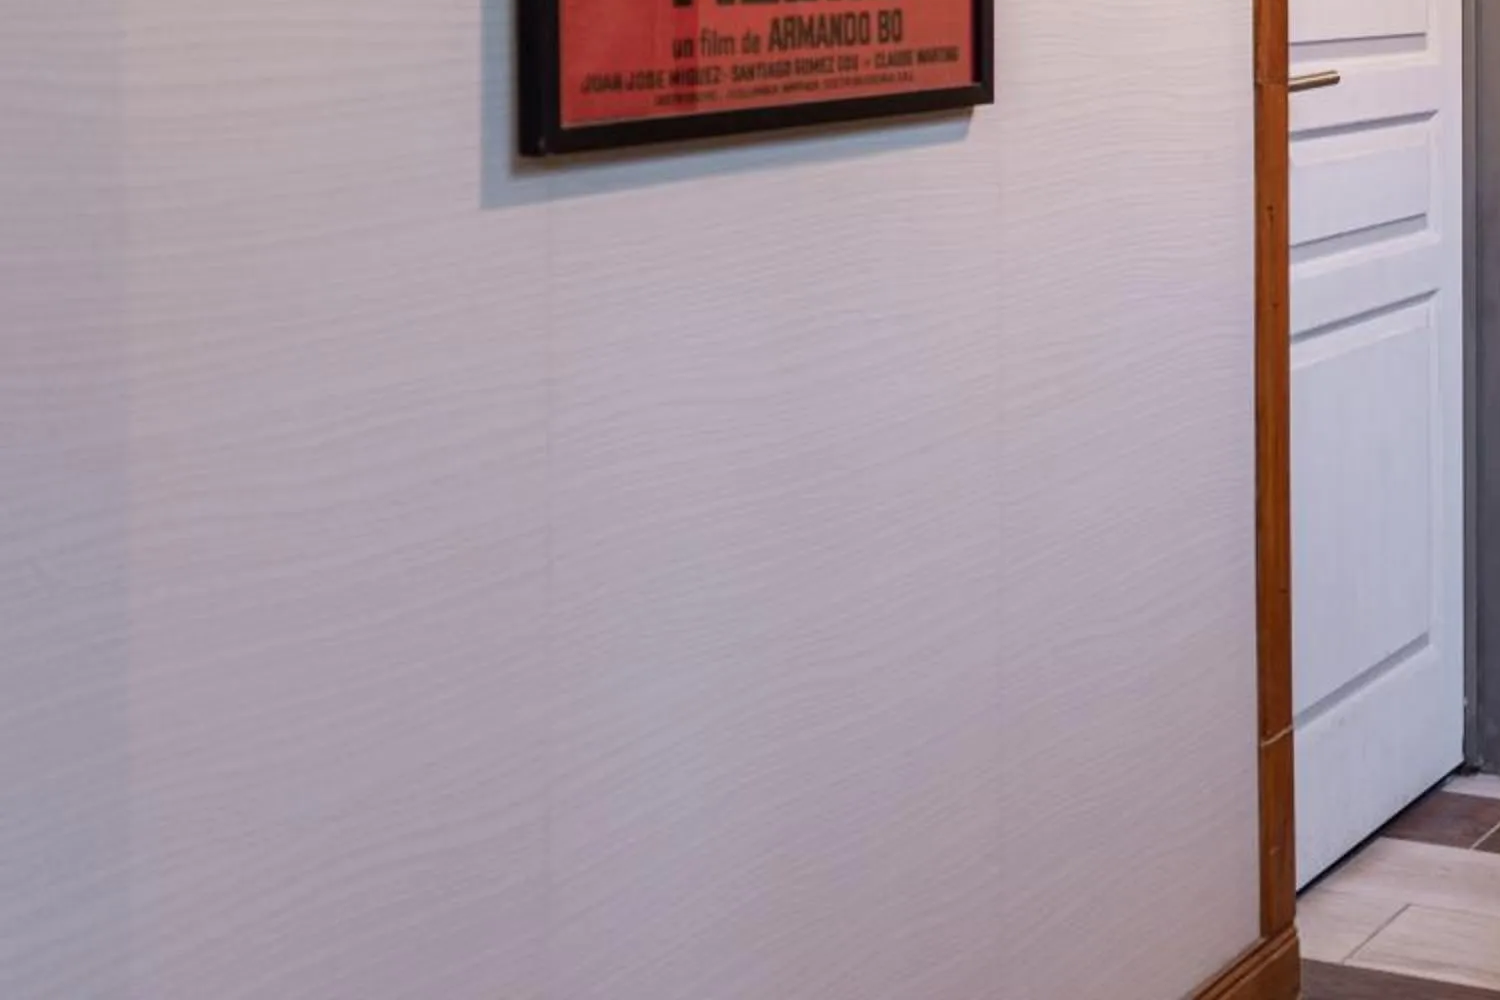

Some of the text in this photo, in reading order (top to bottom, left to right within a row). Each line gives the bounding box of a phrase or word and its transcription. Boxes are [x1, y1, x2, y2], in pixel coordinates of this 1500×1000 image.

[673, 10, 902, 58] un film de ARMANDO BO
[733, 62, 791, 82] SANTIAGO
